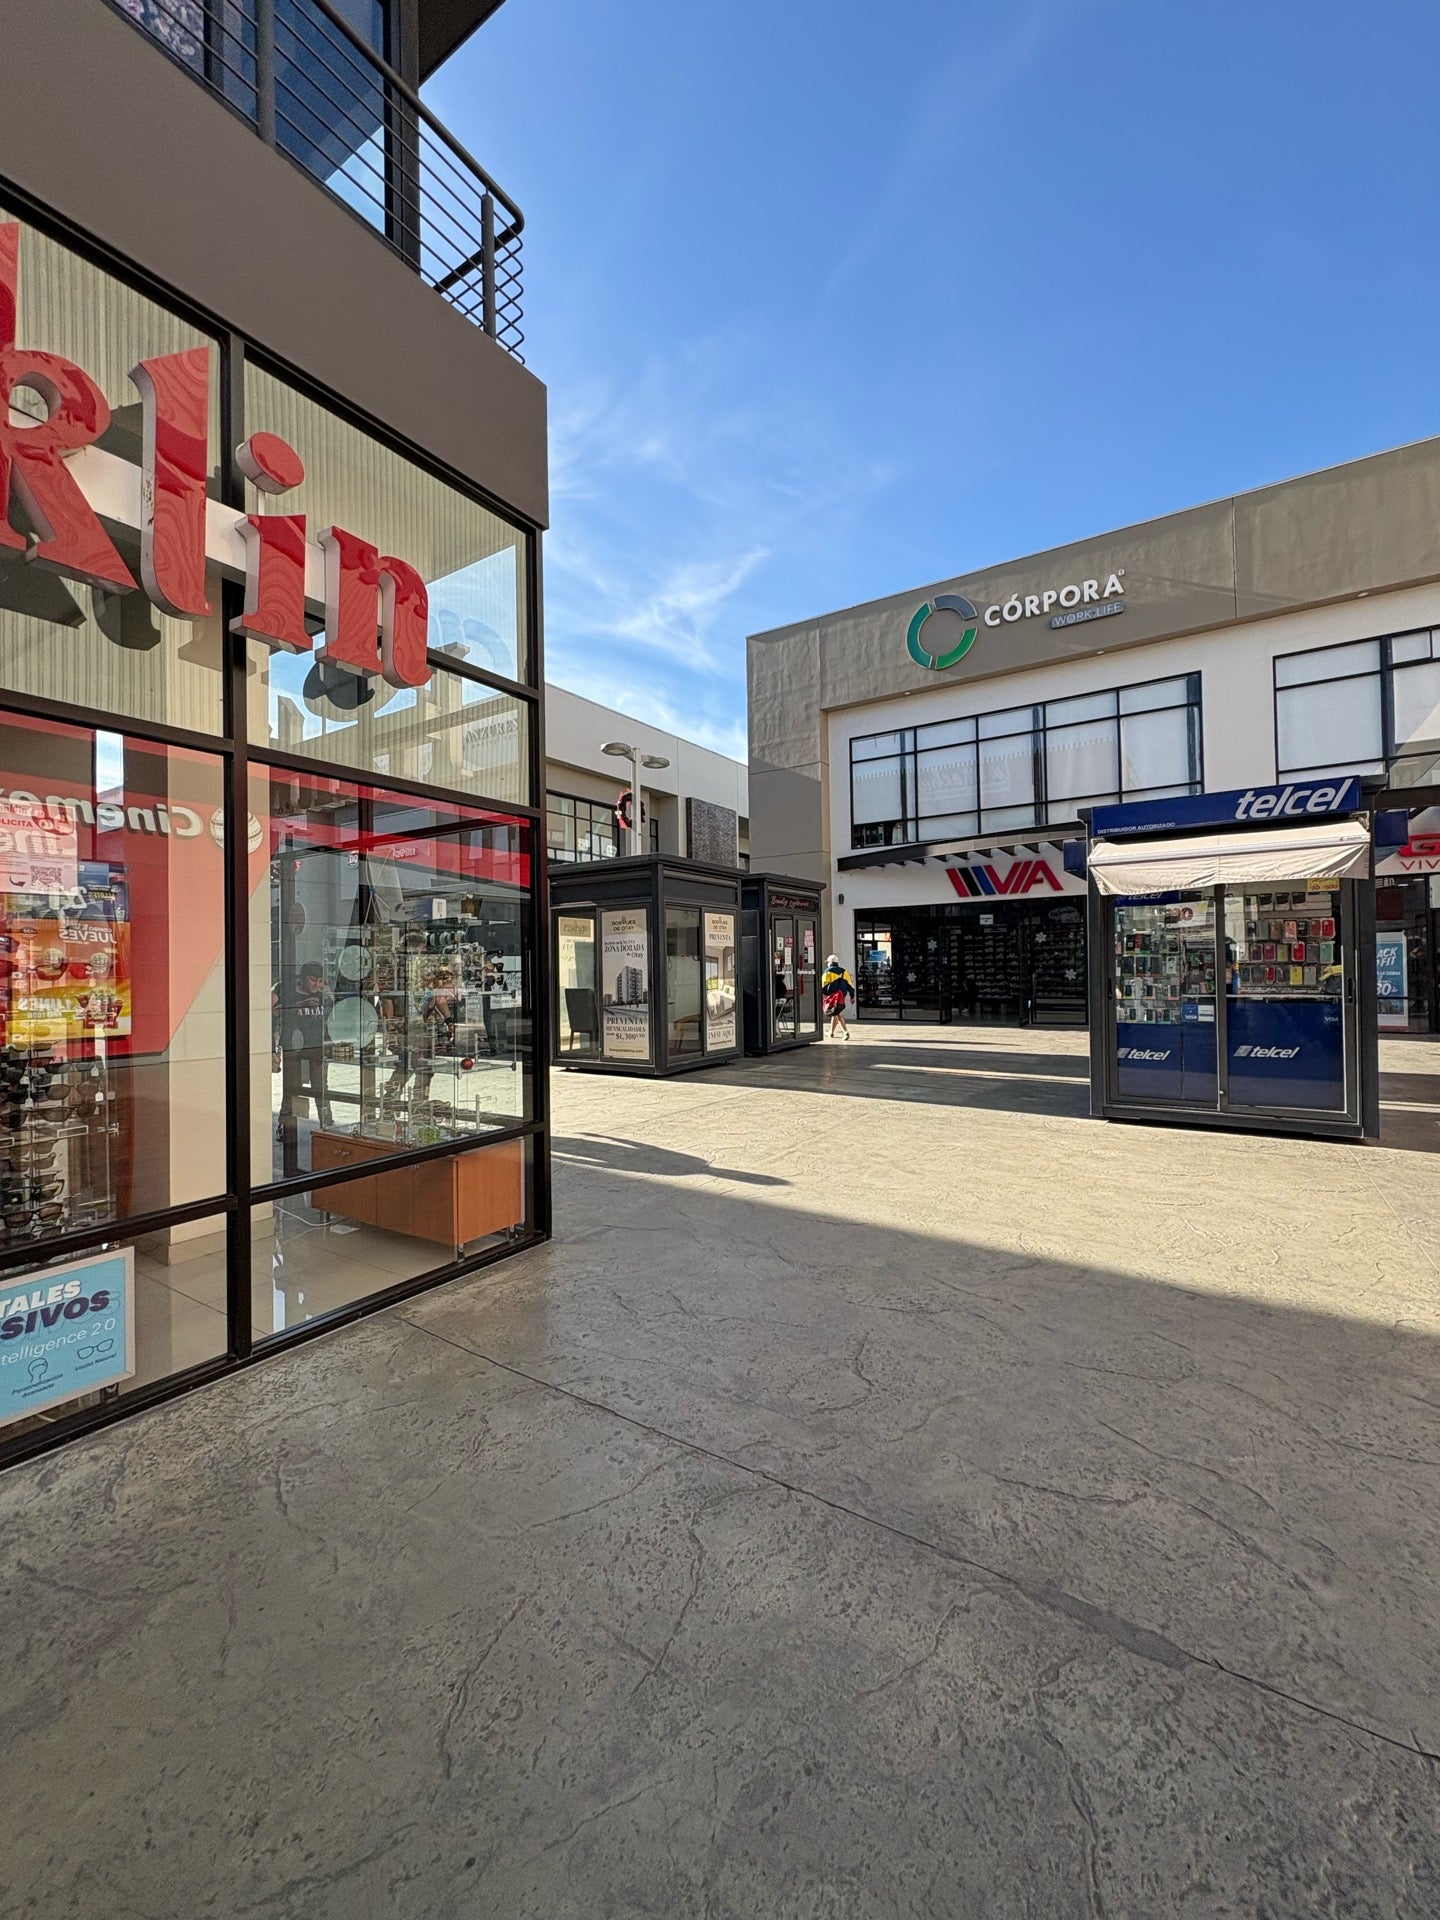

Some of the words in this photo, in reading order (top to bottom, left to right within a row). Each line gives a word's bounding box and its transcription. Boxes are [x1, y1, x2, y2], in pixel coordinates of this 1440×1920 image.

[984, 573, 1124, 627] CÓRPORA
[1236, 778, 1353, 820] telcel
[0, 817, 33, 828] LICITA
[1097, 826, 1137, 834] DISTRIBUIDOR
[1138, 822, 1176, 830] AUTORIZADO
[606, 1016, 643, 1025] PREVENTA
[1127, 1048, 1171, 1061] telcel
[1250, 1046, 1300, 1058] telcel
[0, 1290, 110, 1340] SIVOS
[2, 1329, 87, 1366] telligence
